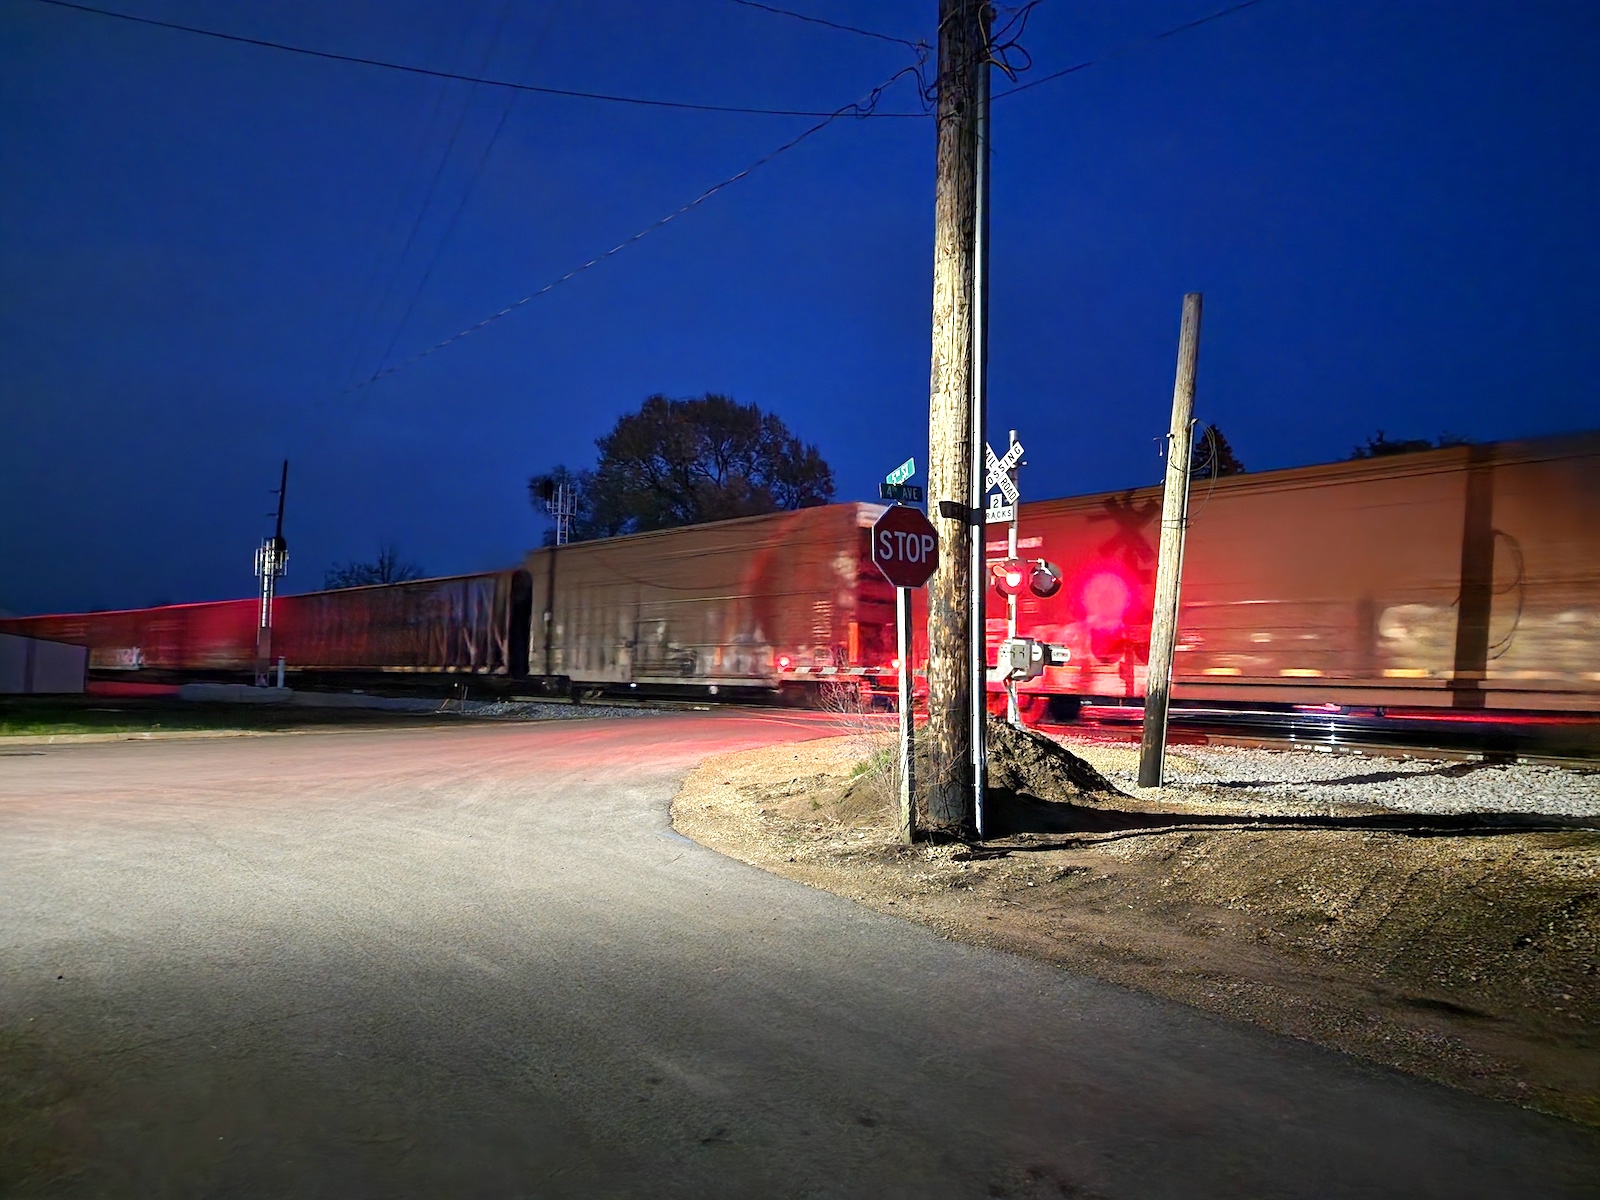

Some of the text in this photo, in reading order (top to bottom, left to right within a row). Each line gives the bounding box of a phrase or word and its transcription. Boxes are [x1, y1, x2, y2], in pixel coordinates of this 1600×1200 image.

[986, 446, 1021, 486] OSSING
[902, 487, 918, 500] AVE
[1000, 477, 1017, 501] ROAD
[993, 498, 999, 509] 2
[986, 509, 1012, 520] RACKS
[879, 529, 935, 564] STOP
